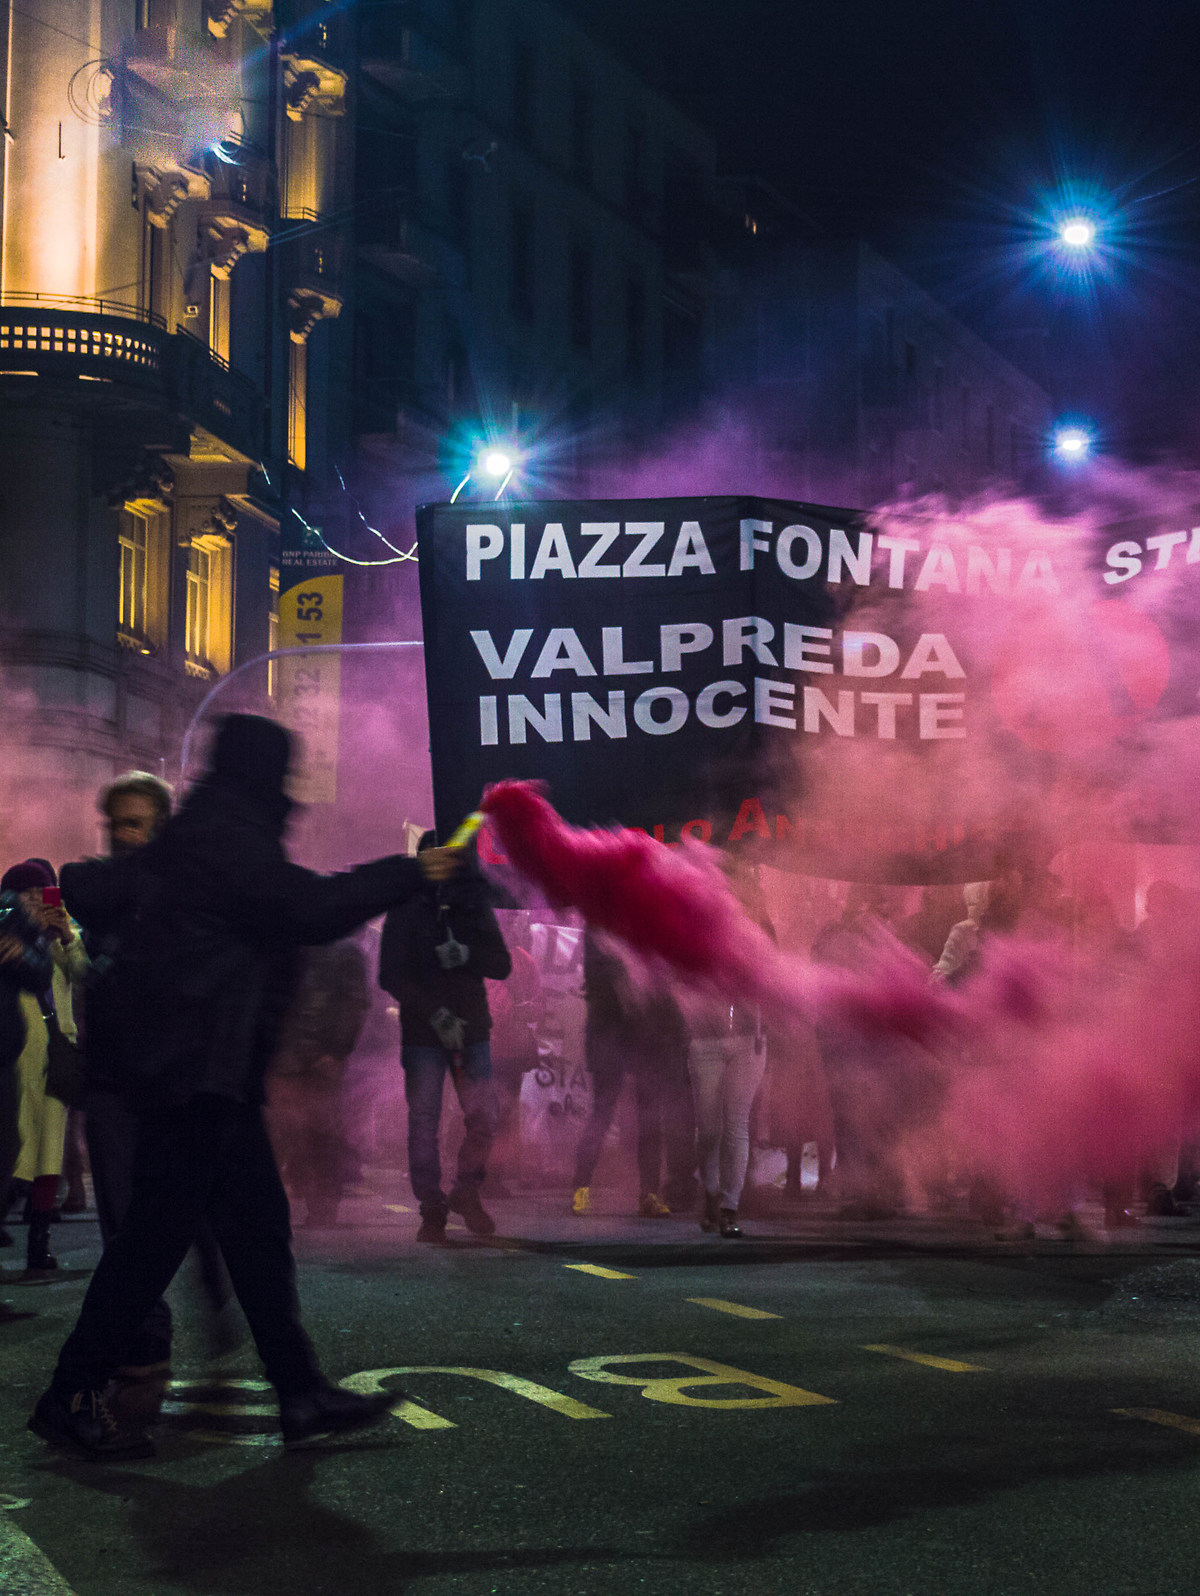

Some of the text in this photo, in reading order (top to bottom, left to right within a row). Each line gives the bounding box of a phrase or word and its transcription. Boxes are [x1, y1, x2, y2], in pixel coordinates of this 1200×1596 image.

[306, 559, 337, 567] ESTATE
[465, 520, 716, 581] PIAZZA
[740, 517, 1061, 597] FONTANA
[296, 592, 324, 622] 53
[470, 616, 967, 681] VALPREDA
[478, 676, 968, 746] INNOCENTE
